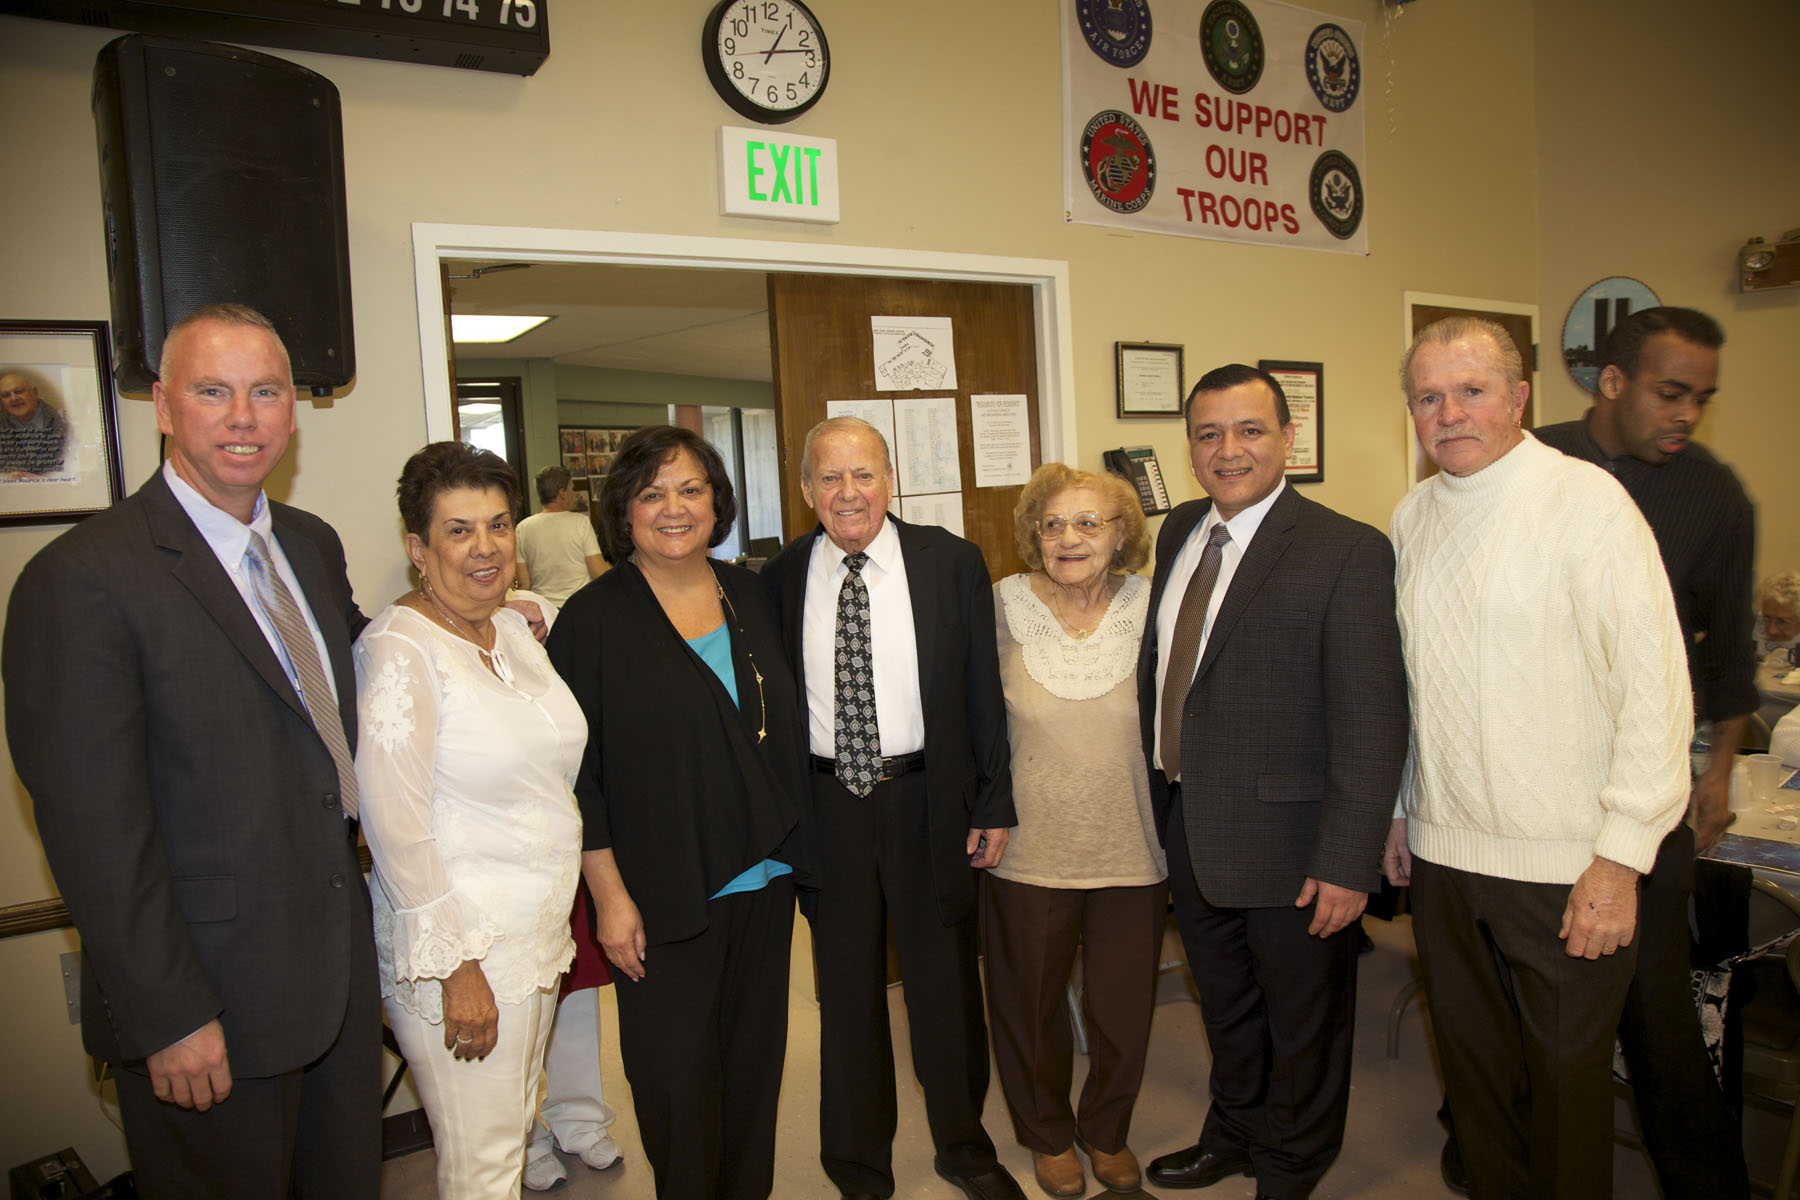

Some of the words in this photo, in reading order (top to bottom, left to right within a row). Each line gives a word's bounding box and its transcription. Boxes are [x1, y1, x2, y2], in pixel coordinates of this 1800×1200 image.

[499, 0, 537, 29] 75
[742, 4, 757, 24] 11
[760, 1, 780, 22] 12
[786, 12, 793, 30] 1
[729, 18, 749, 38] 10
[724, 37, 736, 56] 9
[798, 30, 810, 48] 2
[1089, 32, 1110, 52] AIR
[1113, 40, 1144, 59] FORCE
[804, 49, 816, 68] 3
[733, 61, 745, 79] 8
[798, 71, 810, 88] 4
[748, 76, 760, 94] 7
[766, 84, 778, 103] 6
[786, 82, 797, 101] 5
[1128, 78, 1180, 122] WE
[1195, 93, 1327, 147] SUPPORT
[1087, 113, 1116, 138] UNITED
[1119, 115, 1148, 146] STATES
[746, 140, 821, 206] EXIT
[1205, 144, 1269, 186] OUR
[1089, 179, 1125, 211] MARINE
[1125, 187, 1151, 211] CORPS
[1176, 187, 1300, 235] TROOPS
